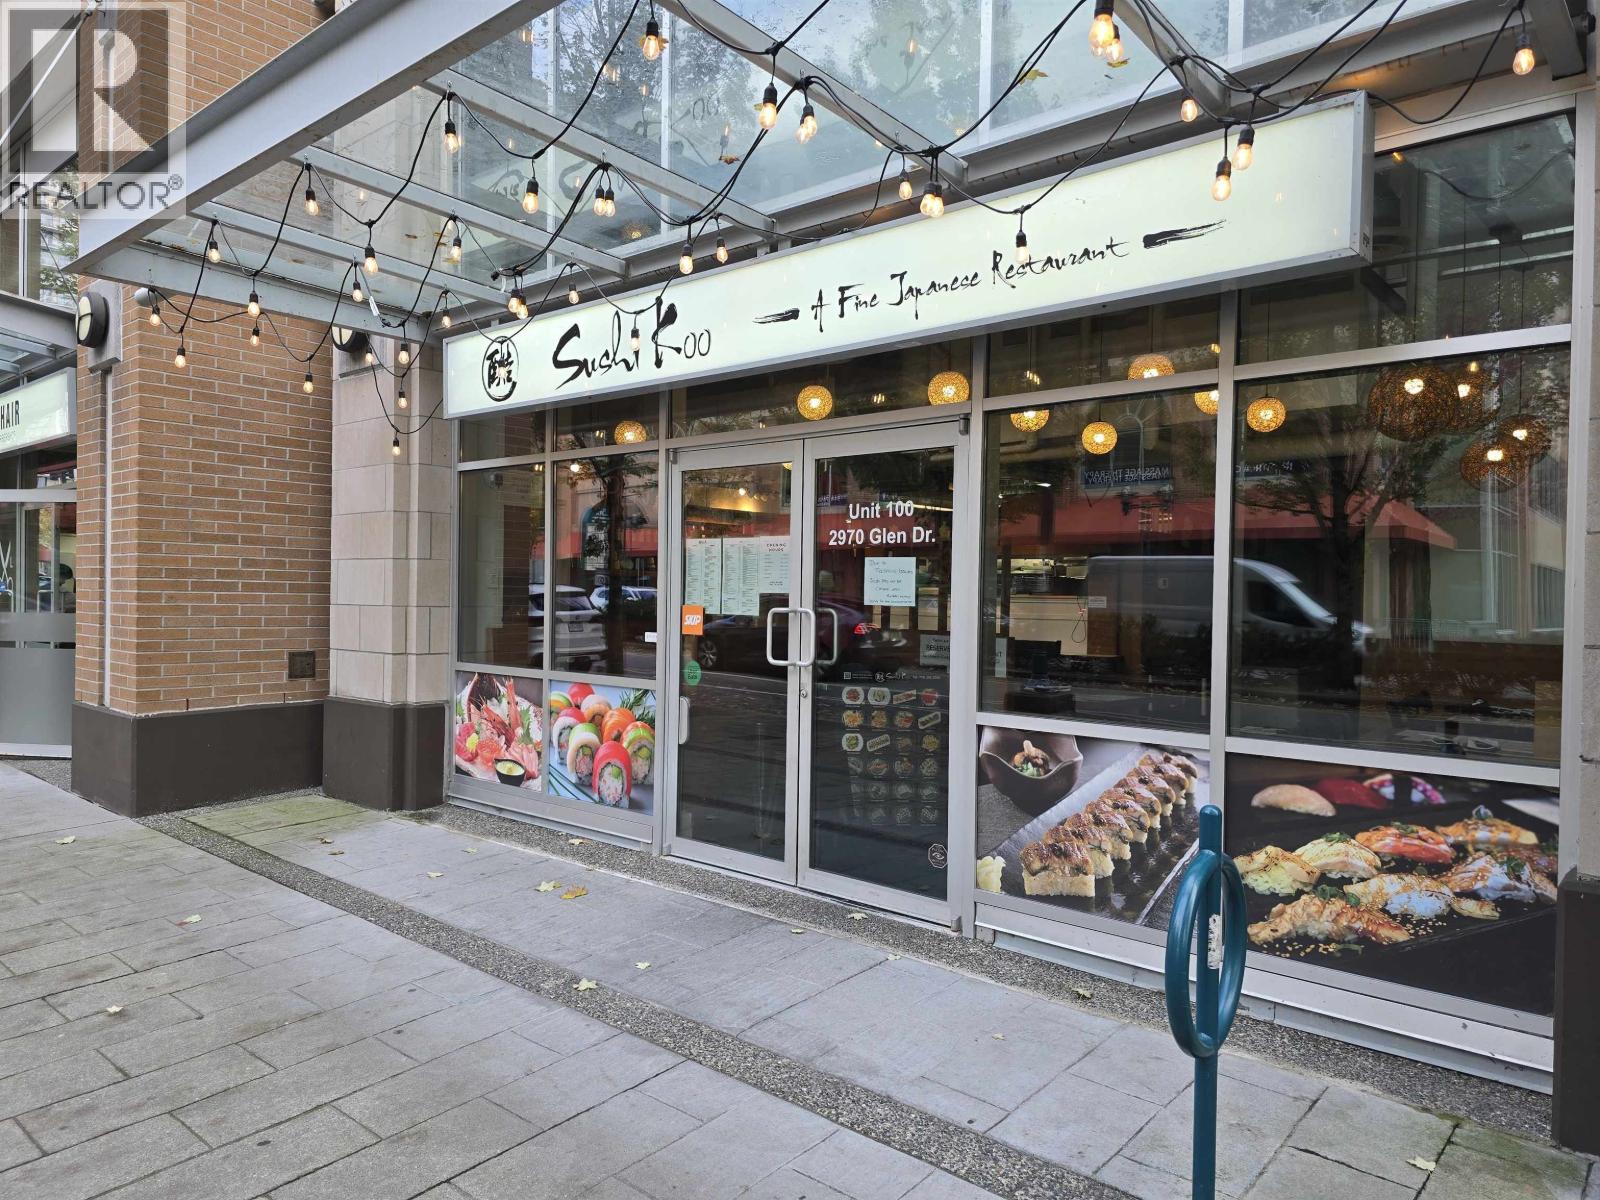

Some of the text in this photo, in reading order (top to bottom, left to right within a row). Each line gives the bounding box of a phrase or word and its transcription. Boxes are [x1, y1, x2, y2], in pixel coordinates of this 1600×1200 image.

[810, 237, 1131, 332] A Fine Japanese Restaurant
[552, 310, 640, 390] Sushi
[1, 400, 20, 430] HAIR
[849, 500, 914, 519] Unit 100
[829, 526, 936, 546] 2970 Glen Dr.
